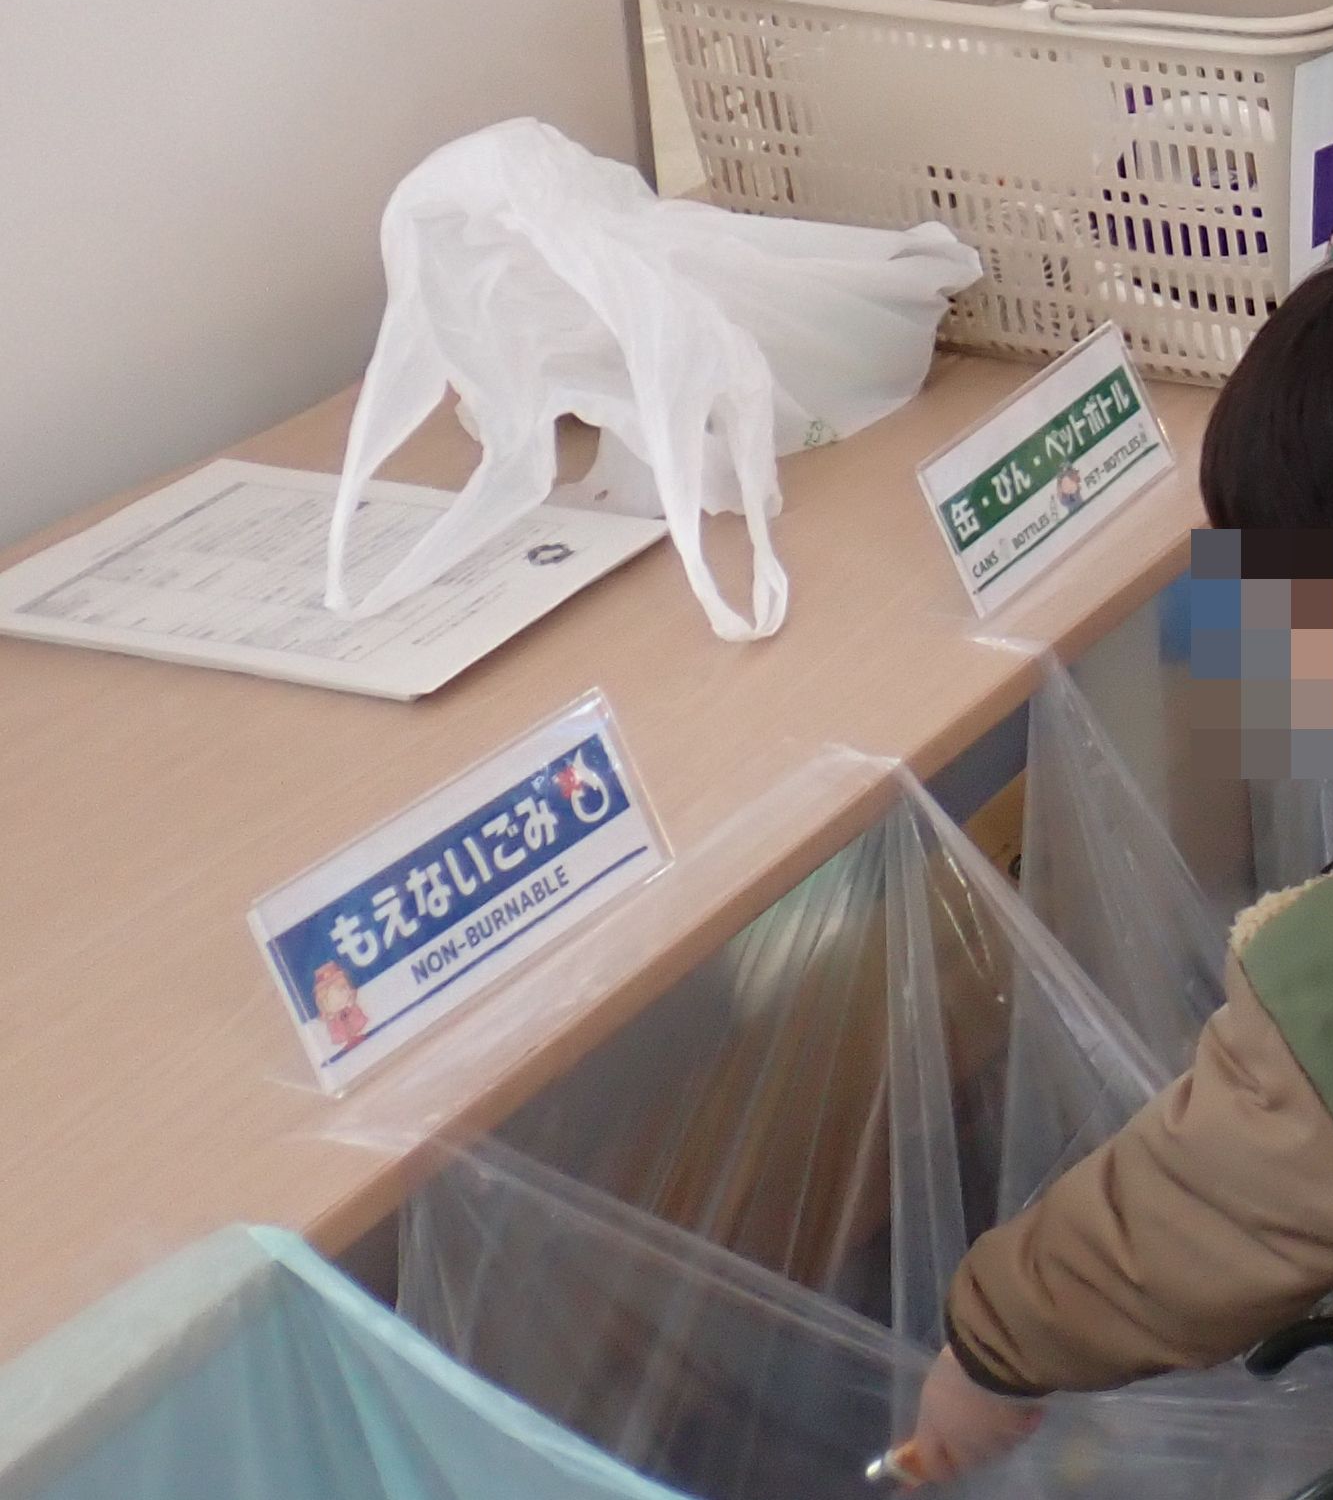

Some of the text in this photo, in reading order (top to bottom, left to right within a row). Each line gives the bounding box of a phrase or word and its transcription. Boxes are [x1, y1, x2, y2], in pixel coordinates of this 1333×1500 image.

[950, 379, 1131, 543] 缶・びん・ペットボトル
[971, 550, 1000, 580] CANS
[1011, 513, 1050, 551] BOTTLES
[328, 792, 561, 968] もえないごみ
[410, 865, 571, 985] NON-BURNABLE
